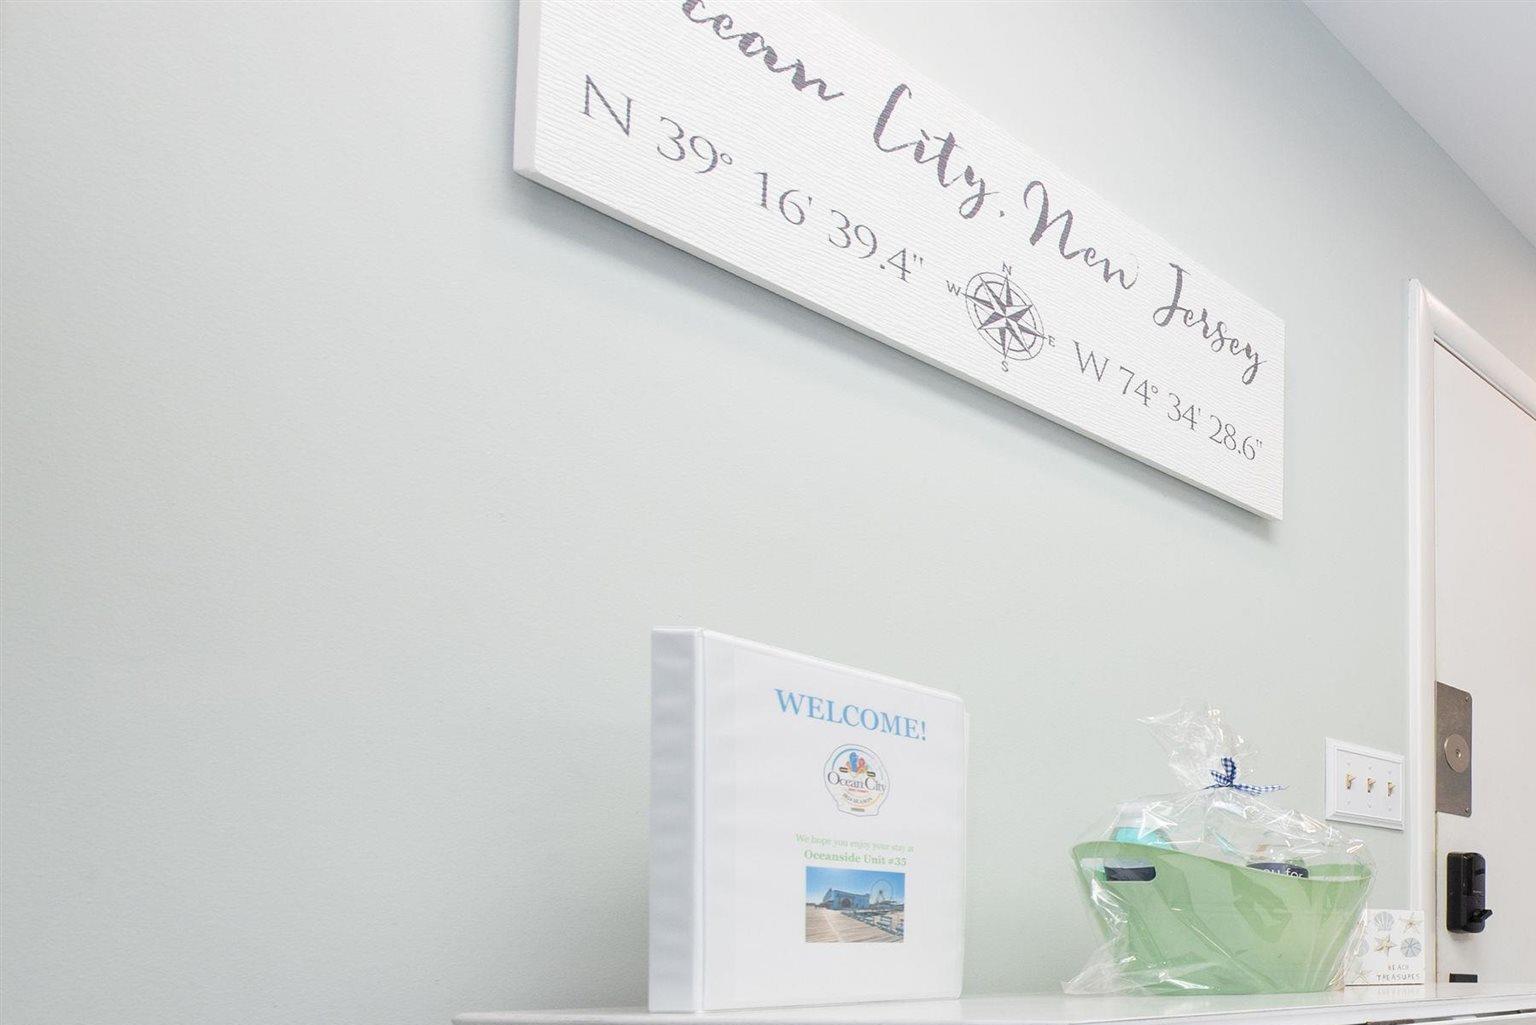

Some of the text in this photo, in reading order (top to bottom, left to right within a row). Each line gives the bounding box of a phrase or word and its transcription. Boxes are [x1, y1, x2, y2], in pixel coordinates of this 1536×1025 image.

[579, 74, 924, 283] N 39° 16' 39.4"
[1002, 261, 1012, 276] N
[946, 279, 961, 296] W
[1023, 180, 1139, 289] New
[1153, 262, 1267, 385] Jersey
[1048, 334, 1056, 348] E
[1001, 360, 1009, 373] S
[1073, 339, 1262, 460] W 74° 34' 28.6"
[774, 688, 928, 741] WELCOME!
[827, 771, 889, 796] Ocean City
[804, 849, 861, 863] Oceanside
[863, 854, 886, 865] Unit
